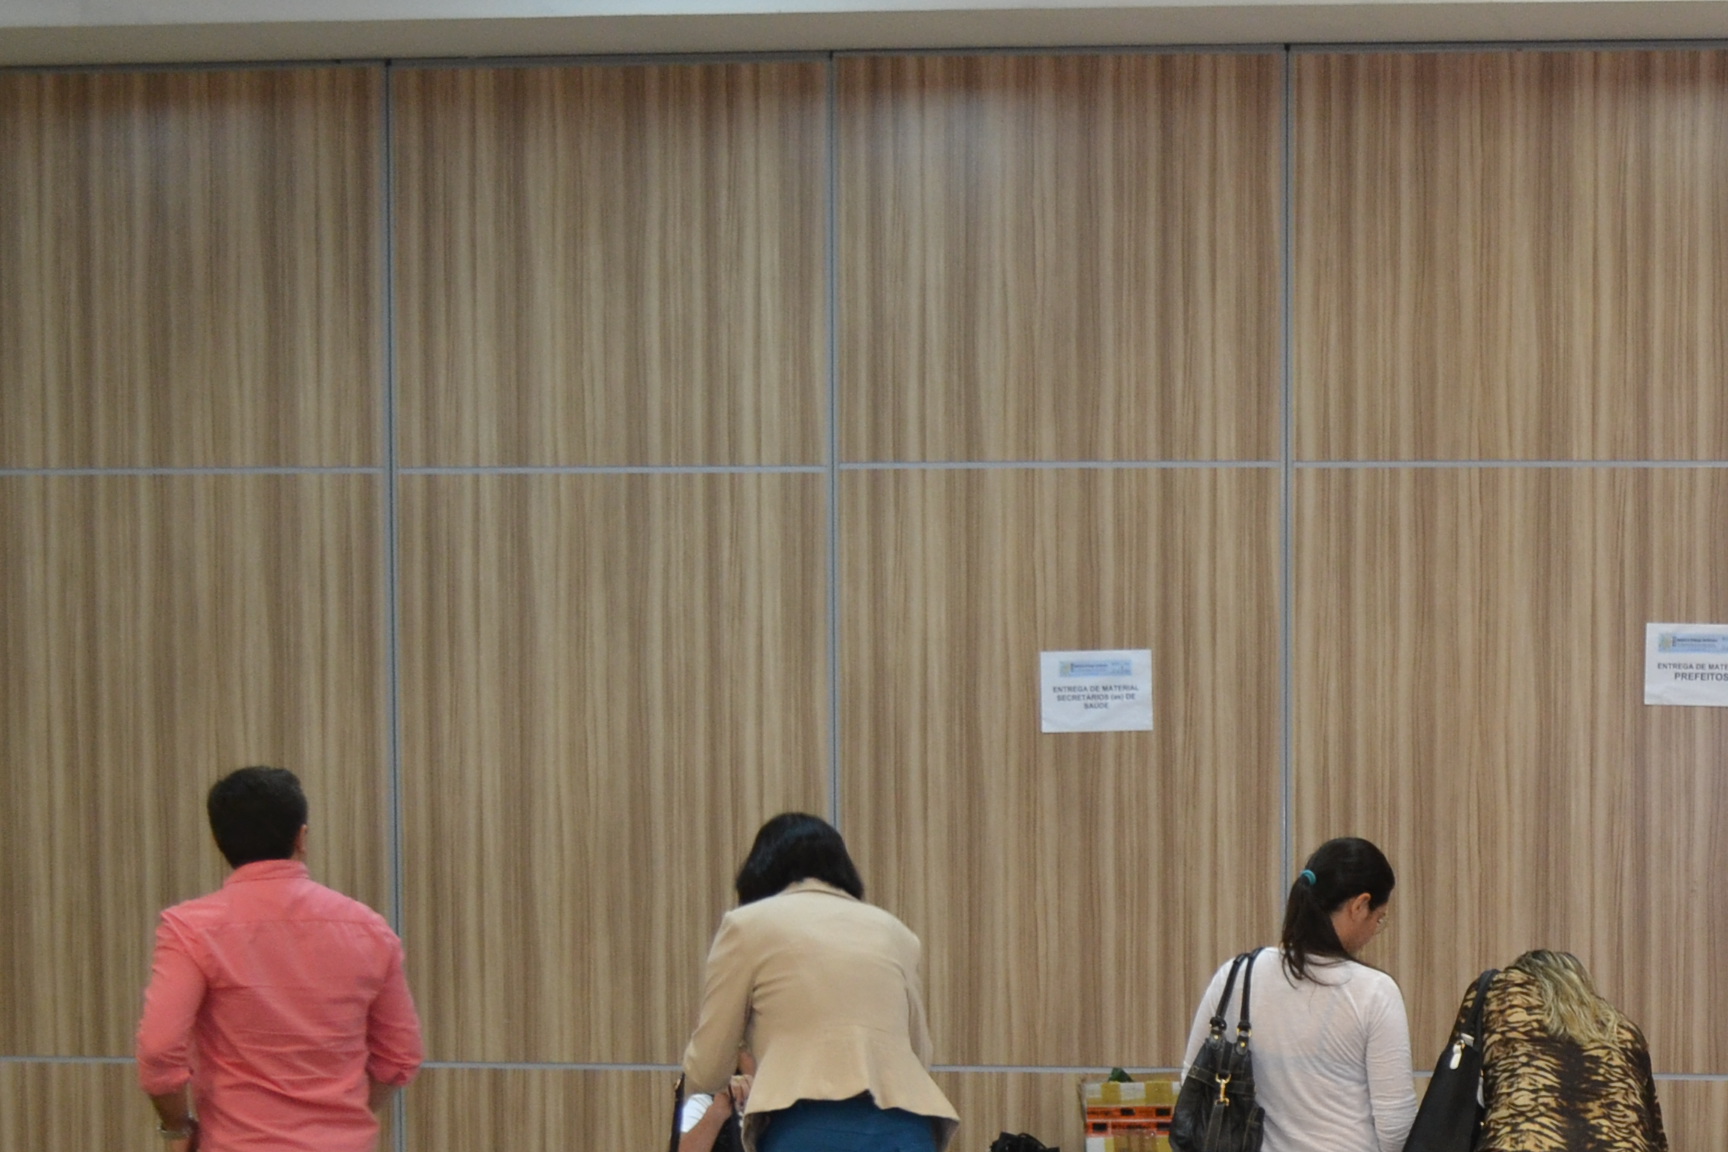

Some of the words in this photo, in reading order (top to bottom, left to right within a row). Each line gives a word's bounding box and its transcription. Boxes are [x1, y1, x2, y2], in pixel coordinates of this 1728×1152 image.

[1657, 662, 1694, 670] ENTREGA
[1102, 684, 1139, 692] MATERIAL
[1125, 692, 1135, 700] DE
